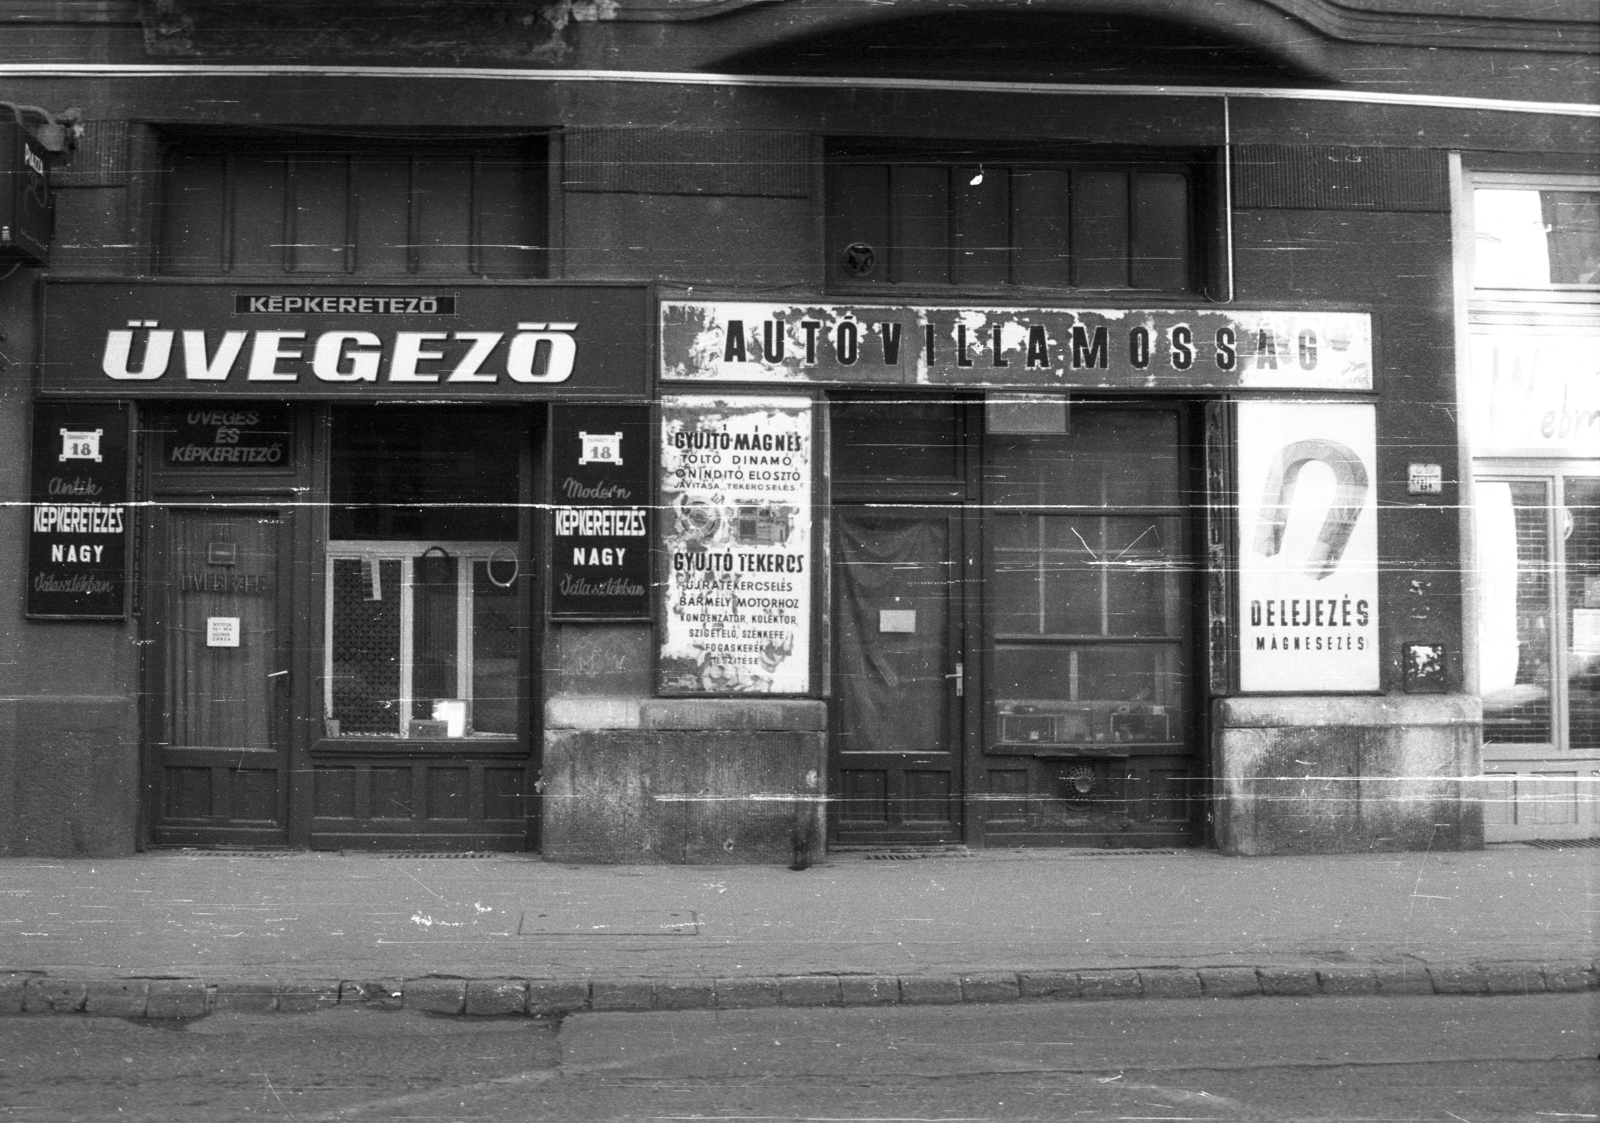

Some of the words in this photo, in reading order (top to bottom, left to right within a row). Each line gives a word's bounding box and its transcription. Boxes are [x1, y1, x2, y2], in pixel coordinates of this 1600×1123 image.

[102, 319, 579, 384] ÜVEGEZŐ
[215, 426, 240, 443] ÉS
[733, 425, 802, 452] MÁGNES
[70, 443, 91, 456] 18
[590, 446, 611, 459] 18
[562, 476, 631, 499] Modern
[52, 544, 103, 563] NAGY
[573, 547, 626, 566] NAGY
[738, 553, 804, 573] TEKERCS
[34, 571, 114, 593] Választékban
[559, 572, 645, 596] Választékban
[736, 597, 800, 609] MOTORHOZ
[1251, 593, 1369, 627] DELEJEZÉS
